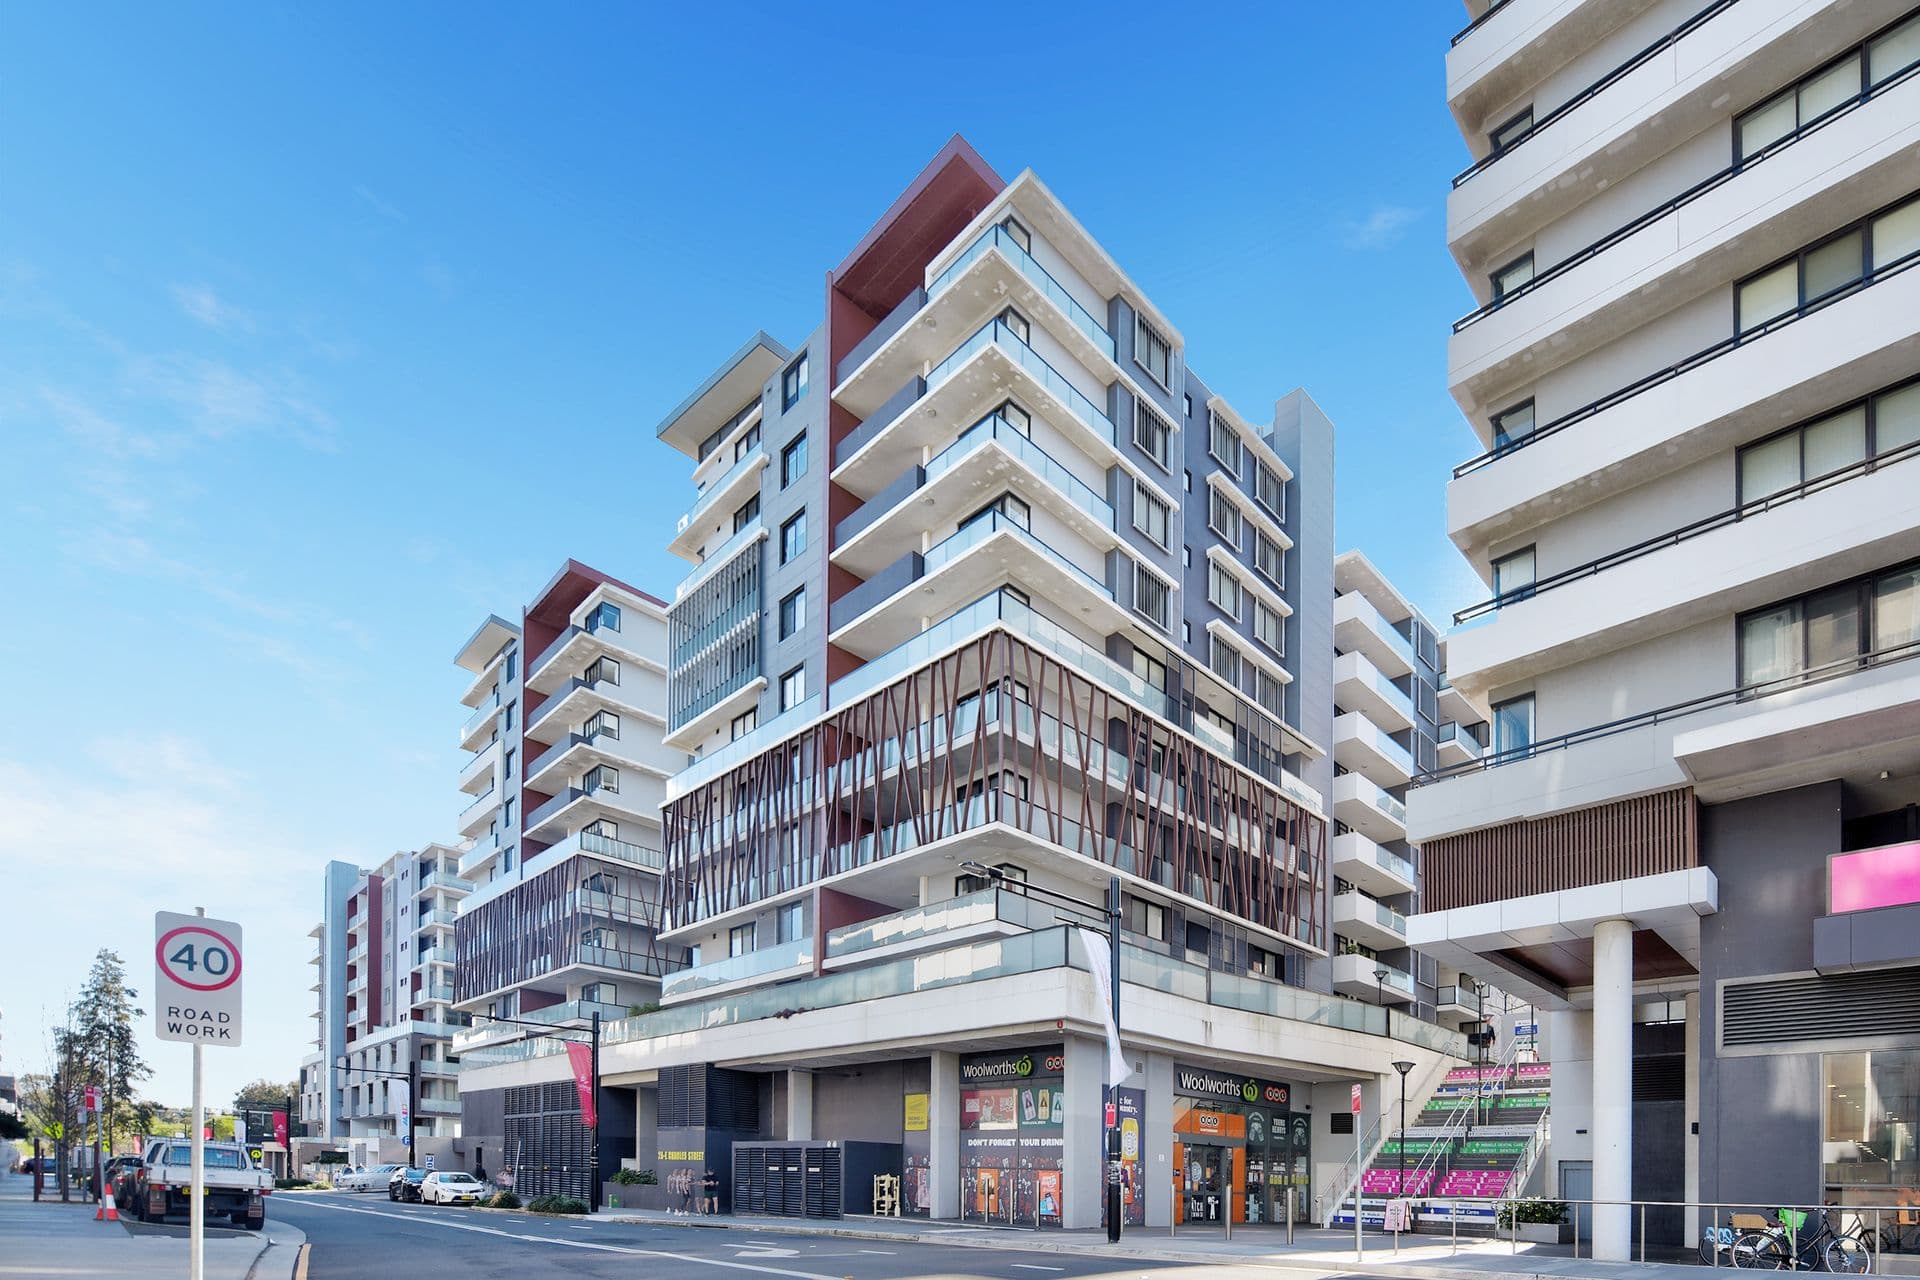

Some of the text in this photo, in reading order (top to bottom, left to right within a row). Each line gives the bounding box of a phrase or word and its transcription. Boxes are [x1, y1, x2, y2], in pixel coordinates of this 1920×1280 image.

[170, 944, 229, 975] 40
[168, 1006, 230, 1023] ROAD
[167, 1022, 231, 1039] WORK
[963, 1060, 1017, 1078] Woolworths
[1180, 1072, 1240, 1097] Woolworths
[968, 1139, 988, 1147] DON'T
[989, 1139, 1017, 1147] FORGET
[1019, 1138, 1040, 1147] YOUR
